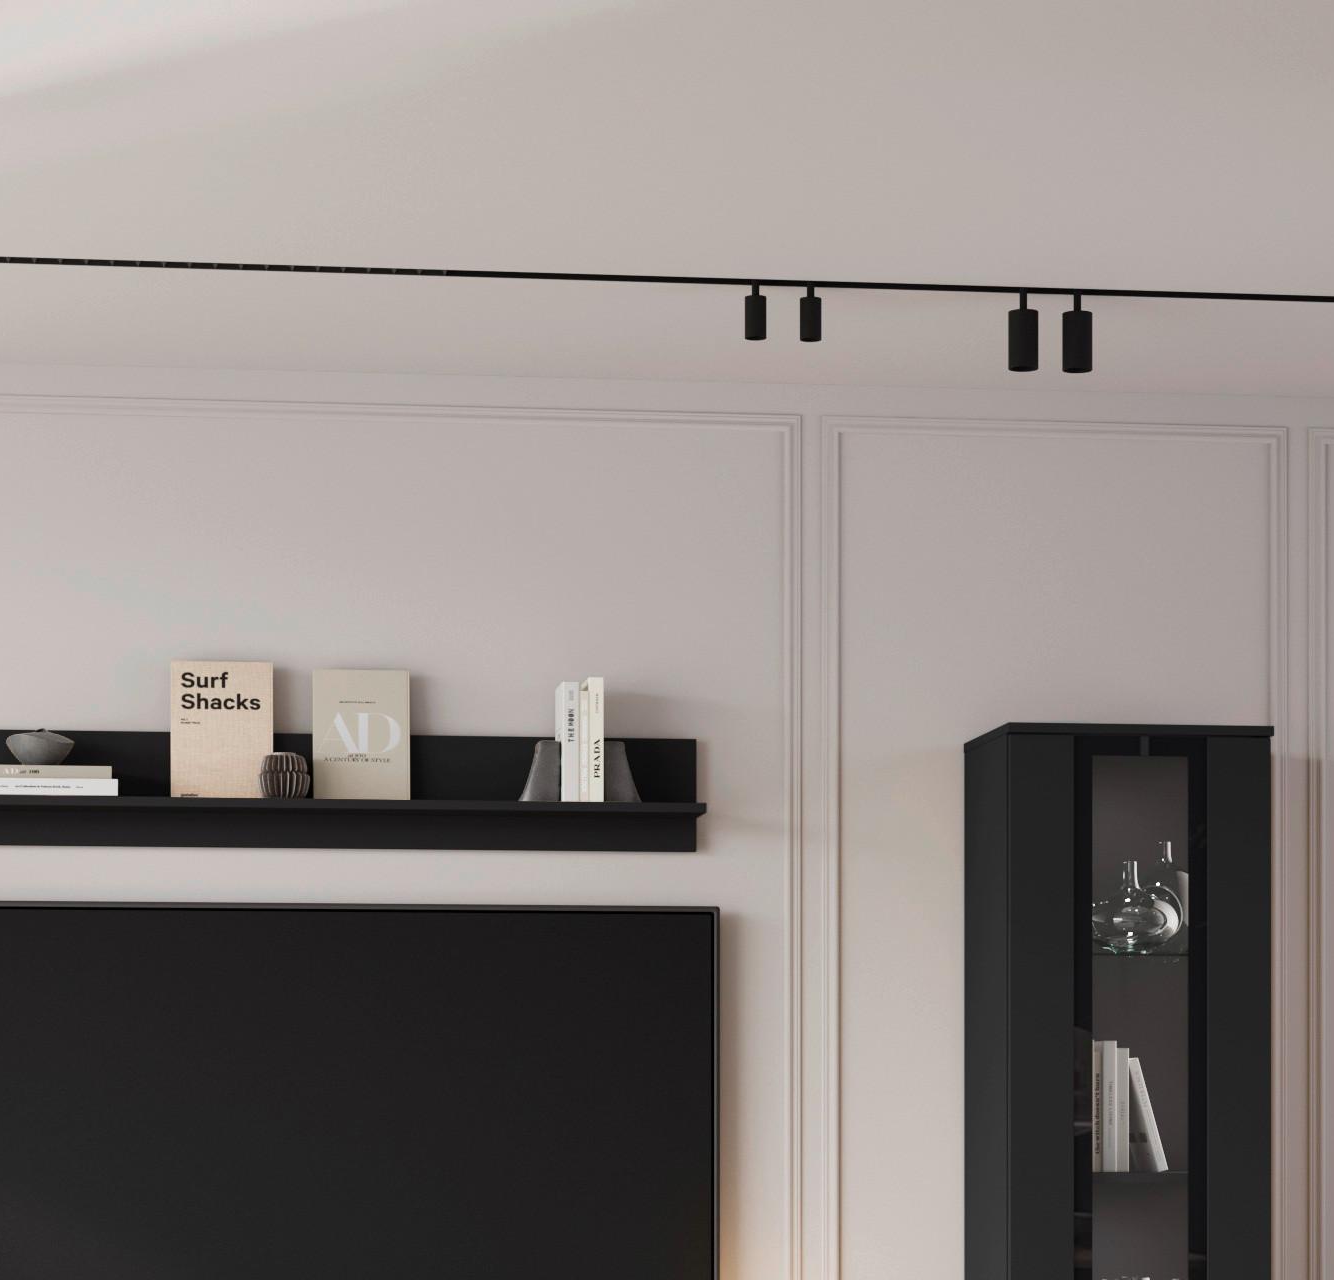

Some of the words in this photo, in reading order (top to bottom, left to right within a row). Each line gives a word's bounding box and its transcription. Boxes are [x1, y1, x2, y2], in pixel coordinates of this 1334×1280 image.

[180, 671, 229, 689] Surf
[180, 692, 262, 711] Shacks
[315, 711, 402, 754] AD
